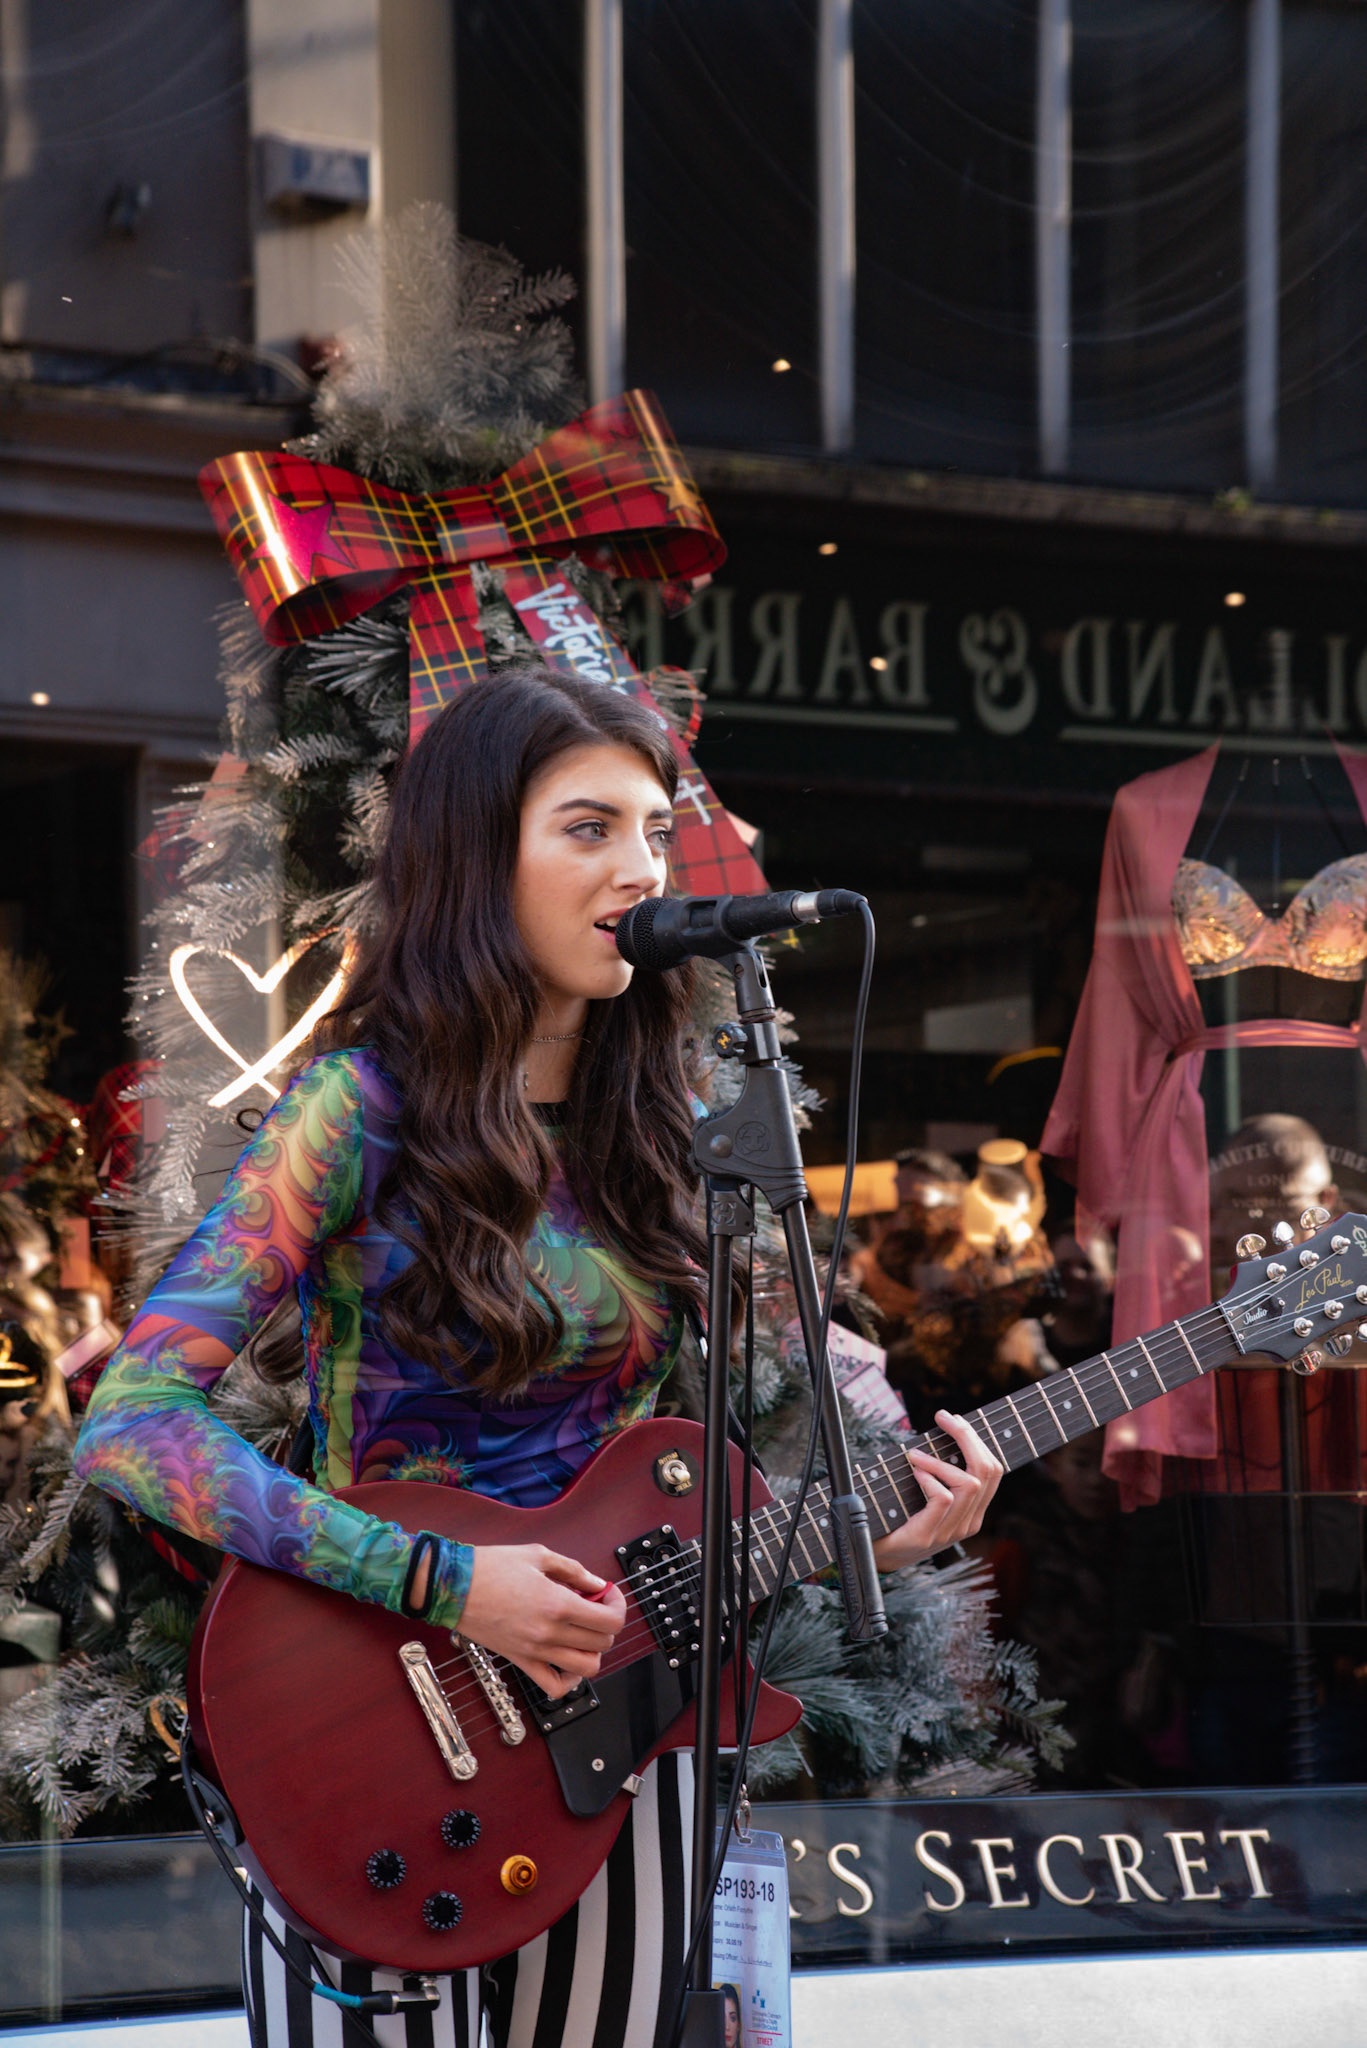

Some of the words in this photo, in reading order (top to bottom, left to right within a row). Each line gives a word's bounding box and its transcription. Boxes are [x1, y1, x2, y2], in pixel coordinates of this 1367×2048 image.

[1294, 1280, 1316, 1314] Les
[1314, 1263, 1344, 1295] Paul
[1243, 1307, 1268, 1325] Studio
[914, 1829, 1275, 1913] SECRET
